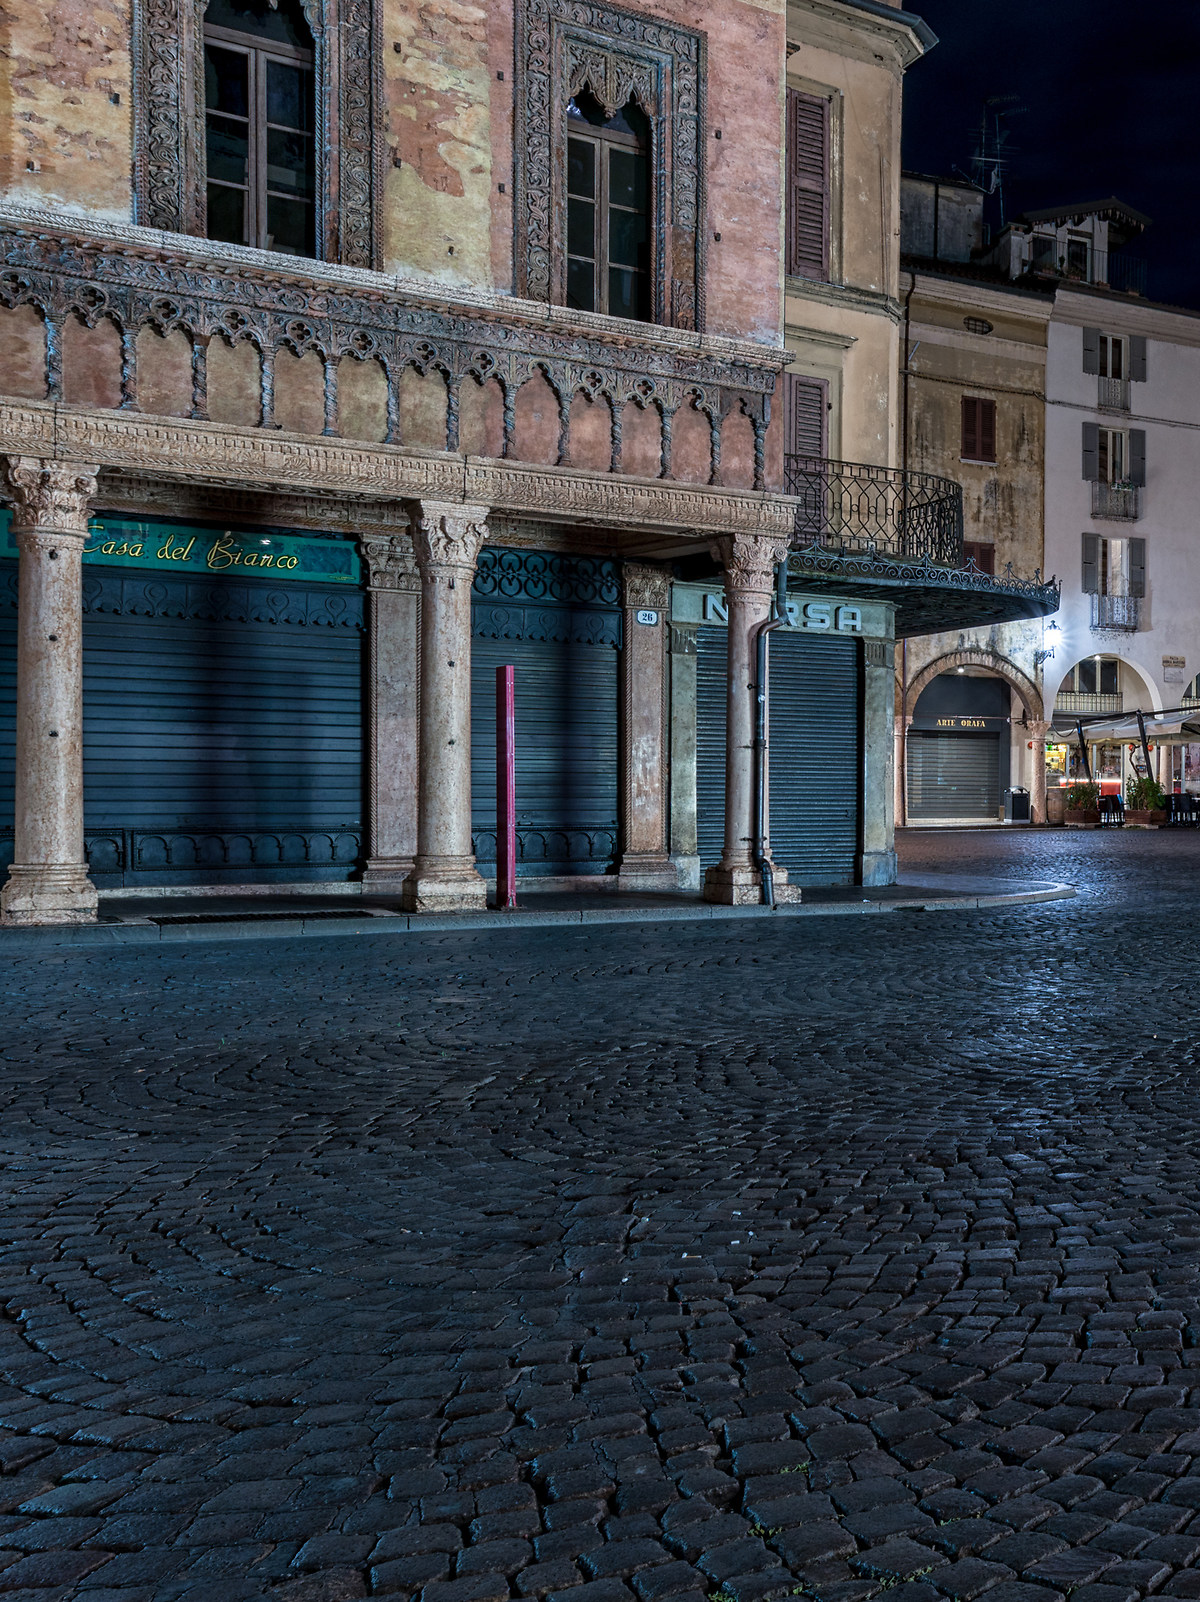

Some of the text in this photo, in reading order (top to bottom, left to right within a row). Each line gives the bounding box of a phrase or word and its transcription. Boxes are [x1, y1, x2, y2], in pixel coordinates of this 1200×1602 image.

[156, 534, 196, 562] del
[207, 537, 299, 569] Bianco
[642, 612, 653, 622] 26
[704, 594, 862, 632] NRSA
[936, 719, 986, 728] ARTE ORAFA
